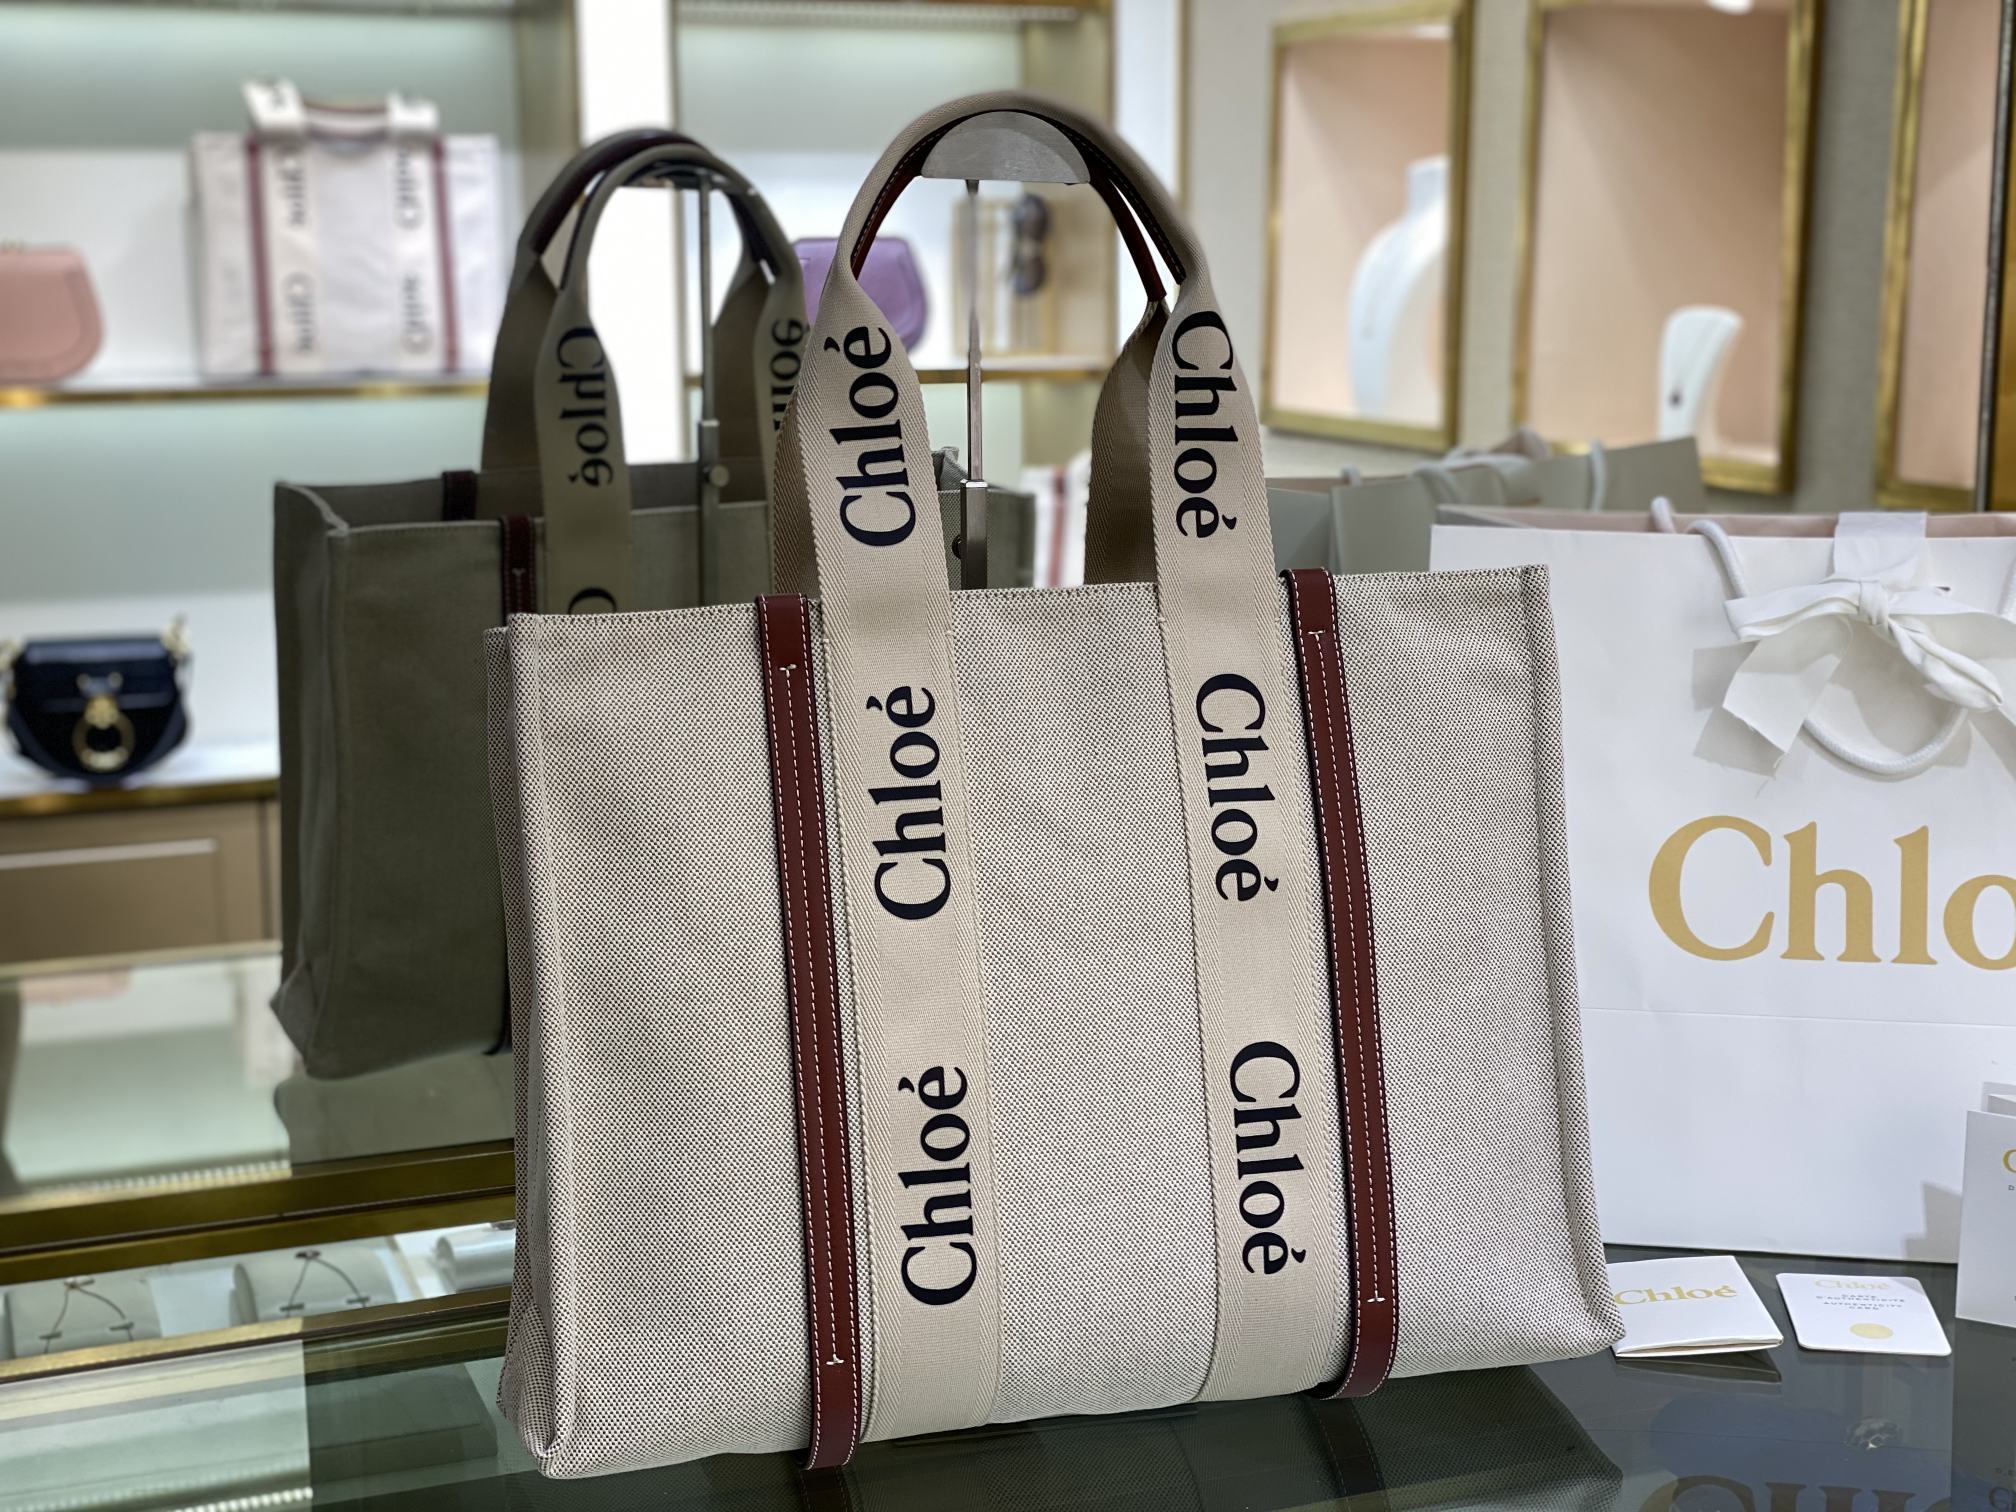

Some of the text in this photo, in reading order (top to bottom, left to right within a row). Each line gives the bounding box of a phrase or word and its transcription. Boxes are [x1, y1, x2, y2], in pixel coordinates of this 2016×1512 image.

[823, 326, 916, 547] Chloé
[1171, 310, 1239, 539] Chloé
[866, 685, 952, 921] Chloé
[1195, 673, 1279, 902] Chloé
[897, 1065, 978, 1306] Chloé
[1229, 1041, 1308, 1275] Chloé
[1613, 1284, 1738, 1305] Chloé
